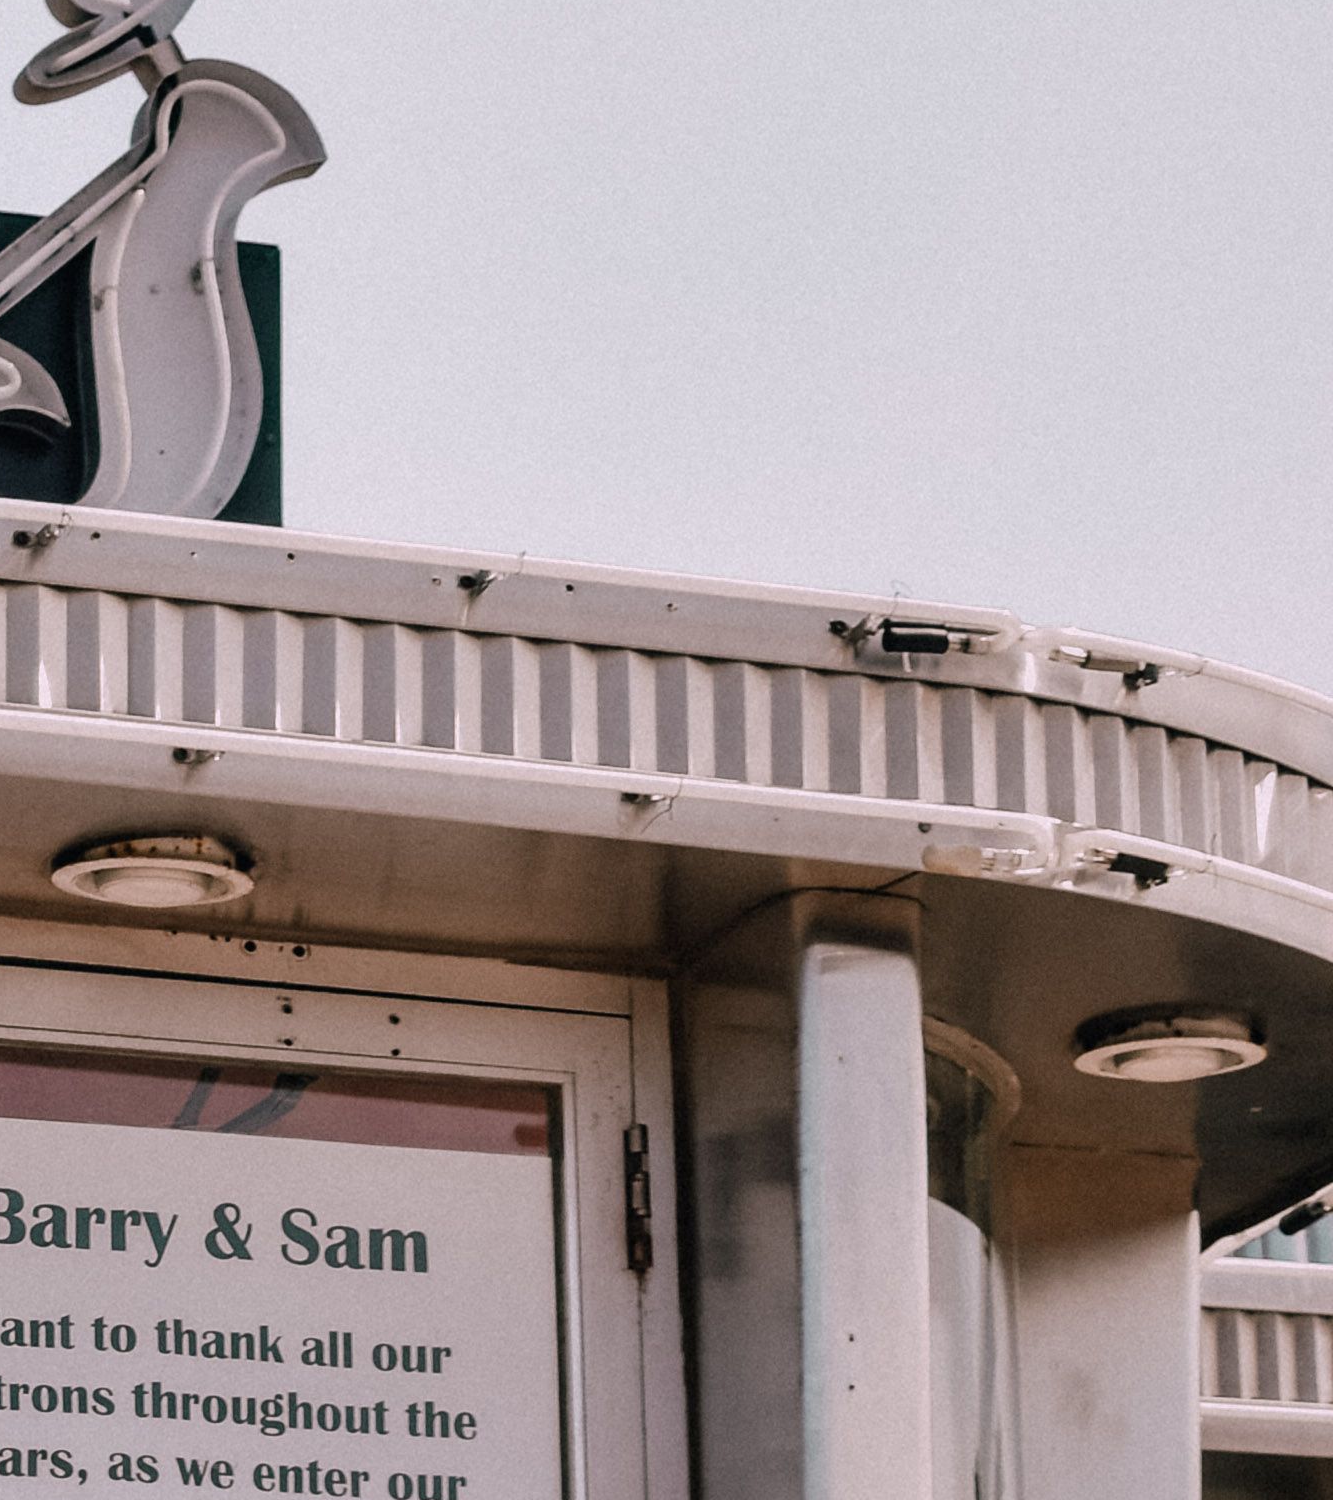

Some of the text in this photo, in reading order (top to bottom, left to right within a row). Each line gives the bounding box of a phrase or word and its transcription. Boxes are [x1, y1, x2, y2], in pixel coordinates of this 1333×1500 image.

[205, 1203, 253, 1260] &
[281, 1208, 428, 1273] Sam
[91, 1317, 136, 1352] to
[155, 1319, 284, 1363] thank
[301, 1331, 352, 1368] all
[373, 1344, 451, 1373] our
[131, 1382, 389, 1436] throughout
[405, 1401, 476, 1440] the
[108, 1453, 159, 1483] as
[176, 1458, 234, 1489] we
[253, 1461, 369, 1497] enter
